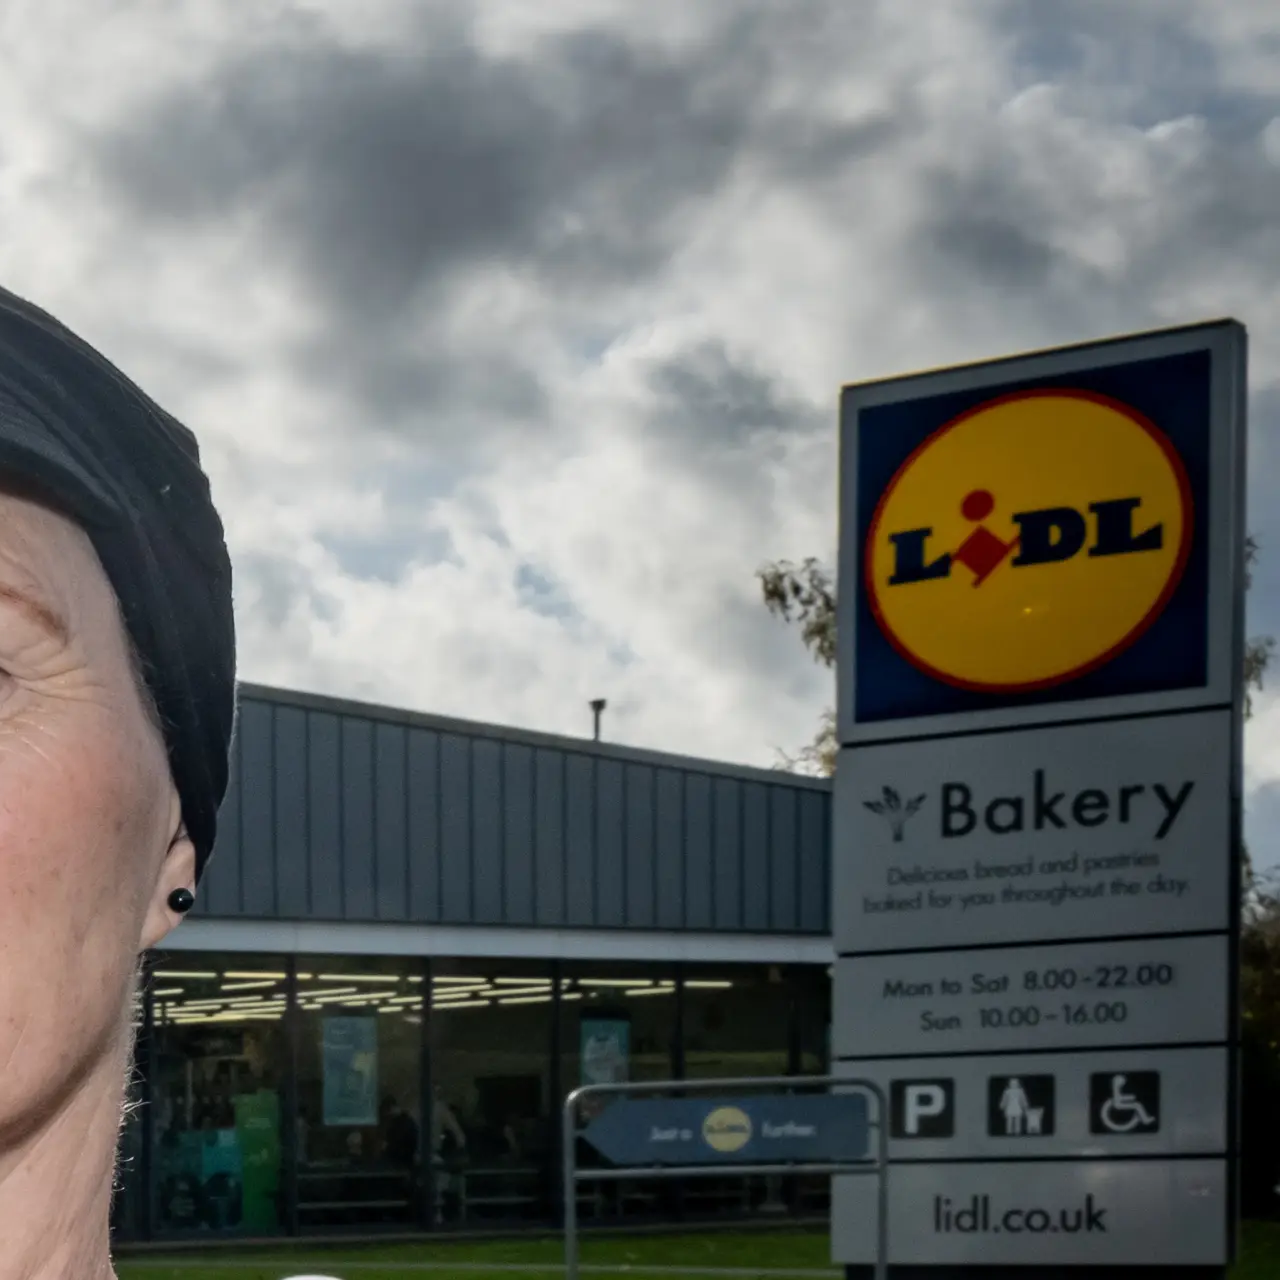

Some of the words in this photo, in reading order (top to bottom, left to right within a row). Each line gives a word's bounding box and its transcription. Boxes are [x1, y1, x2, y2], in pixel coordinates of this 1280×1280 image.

[941, 769, 1195, 840] Bakery
[887, 863, 968, 886] Delicious
[974, 855, 1033, 879] bread
[1039, 851, 1078, 873] and
[928, 888, 951, 908] for
[959, 893, 995, 912] you
[1001, 880, 1106, 906] throughout
[1110, 876, 1141, 896] the
[883, 978, 933, 998] Mon
[941, 976, 963, 996] to
[970, 973, 1009, 995] Sat
[920, 1010, 961, 1031] Sun
[905, 1084, 946, 1134] P
[934, 1193, 1107, 1233] lidl.co.uk
